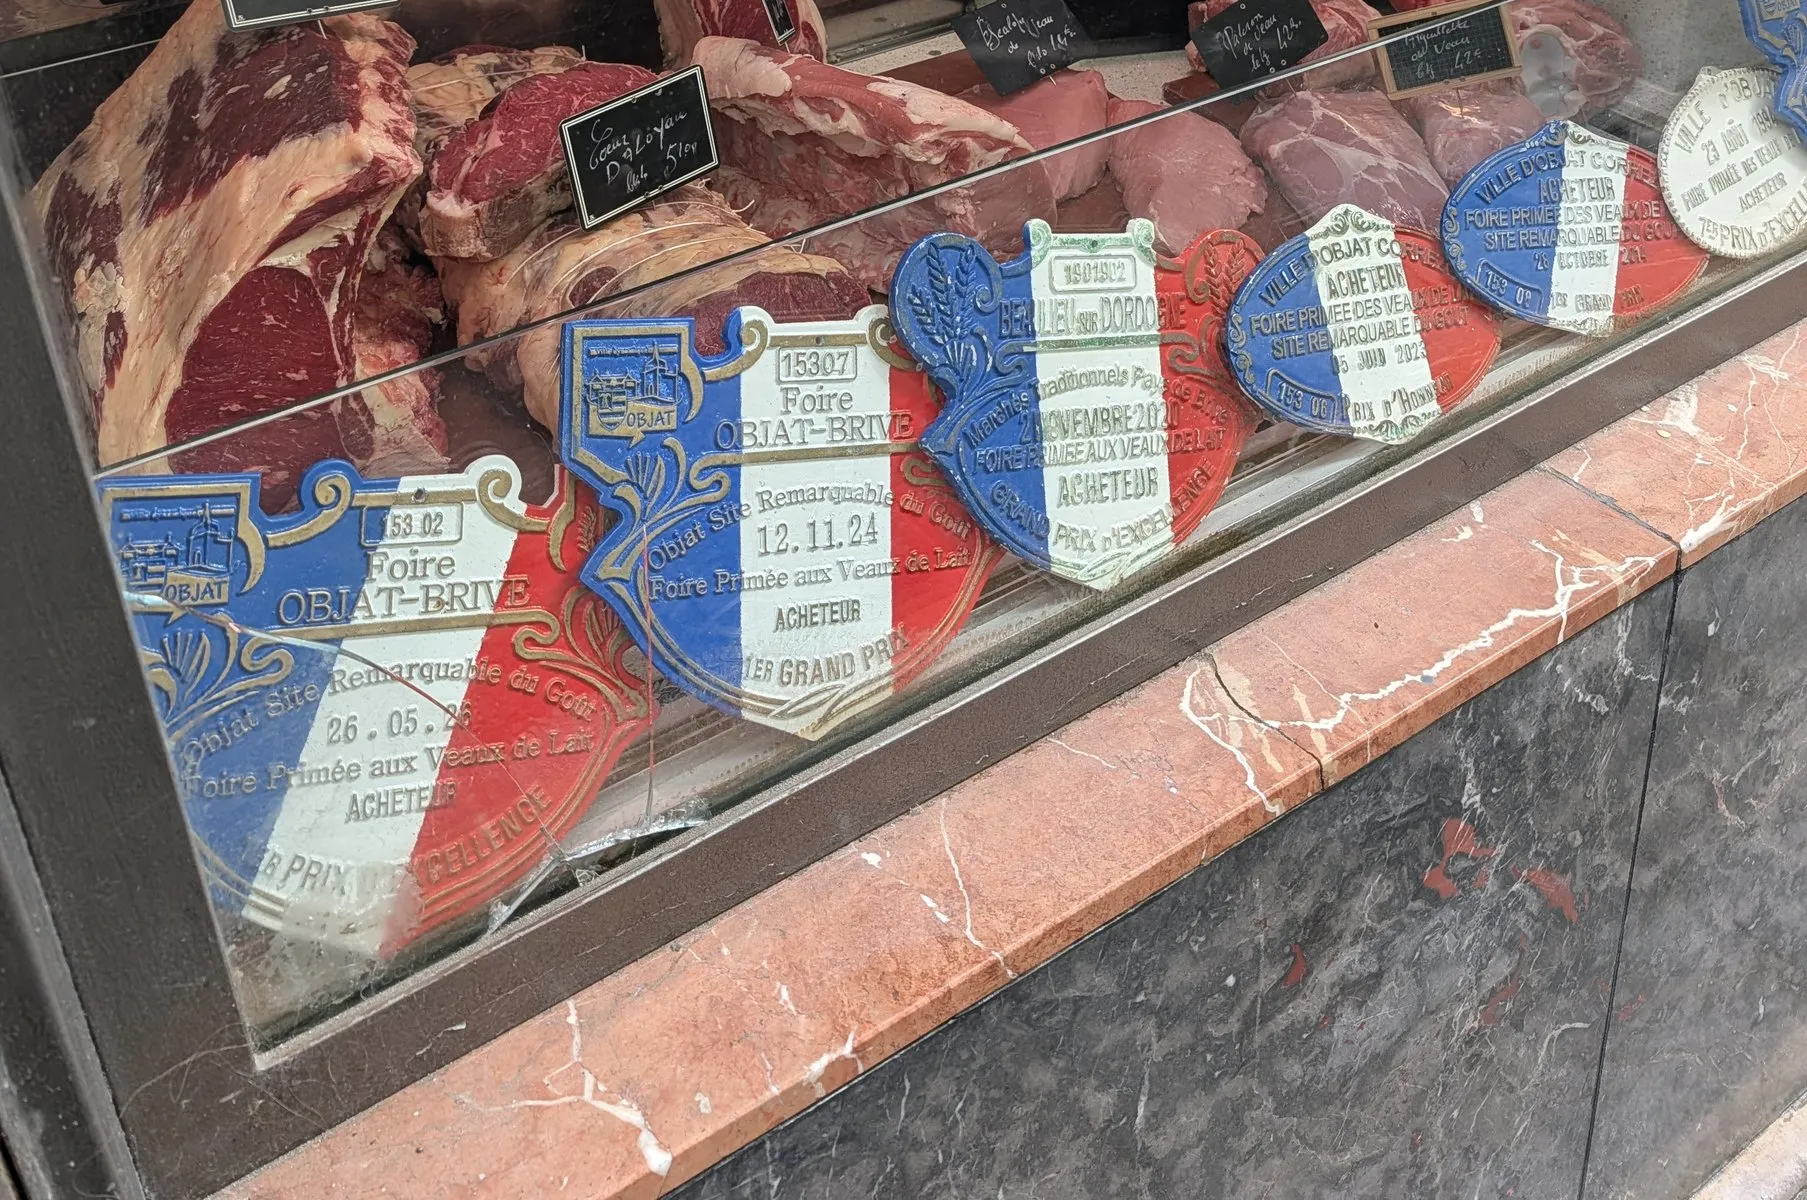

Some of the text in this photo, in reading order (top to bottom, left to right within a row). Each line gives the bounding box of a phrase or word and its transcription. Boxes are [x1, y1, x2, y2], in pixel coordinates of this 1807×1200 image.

[1674, 100, 1711, 154] VILLE
[1474, 162, 1521, 205] VILLE
[1519, 148, 1587, 178] D'OBJAT
[1538, 176, 1616, 205] ACHETEUR
[1738, 171, 1788, 213] ACHETEUR
[1464, 208, 1509, 230] FOIRE
[1564, 204, 1594, 226] DES
[1484, 230, 1517, 252] SITE
[1518, 224, 1620, 250] REMARQUABLE
[1719, 224, 1759, 251] PRIX
[1258, 258, 1306, 308] VILLE
[1325, 262, 1407, 300] ACHETEUR
[1250, 309, 1296, 338] FOIRE
[1354, 297, 1383, 321] DES
[1272, 335, 1306, 361] SITE
[1307, 315, 1412, 355] REMARQUABLE
[780, 352, 854, 378] 15307
[1357, 347, 1386, 371] JUIN
[780, 386, 854, 415] Foire
[1277, 380, 1328, 419] 153 06
[626, 411, 675, 429] OBJAT
[715, 412, 915, 450] OBJAT-BRIVE
[974, 445, 1024, 475] FOIRE
[1056, 467, 1159, 508] ACHETEUR
[647, 523, 707, 571] Objat
[709, 501, 753, 532] Site
[756, 480, 895, 514] Remarquable
[900, 491, 925, 516] du
[989, 480, 1051, 540] GRAND
[1052, 521, 1098, 554] PRIX
[365, 549, 457, 583] Foire
[649, 546, 973, 600] Foire Primée aux Veaux de Lait
[163, 581, 230, 603] OBJAT
[278, 574, 532, 625] OBJAT-BRIVE
[773, 598, 862, 634] ACHETEUR
[744, 620, 910, 688] 1ER GRAND PRIX
[182, 707, 259, 762] Objat
[265, 682, 321, 717] Site
[327, 653, 502, 696] Remarquable
[509, 664, 540, 695] du
[180, 727, 594, 799] Foire Primée aux Veaux de Lait
[345, 781, 457, 822] ACHETEUR
